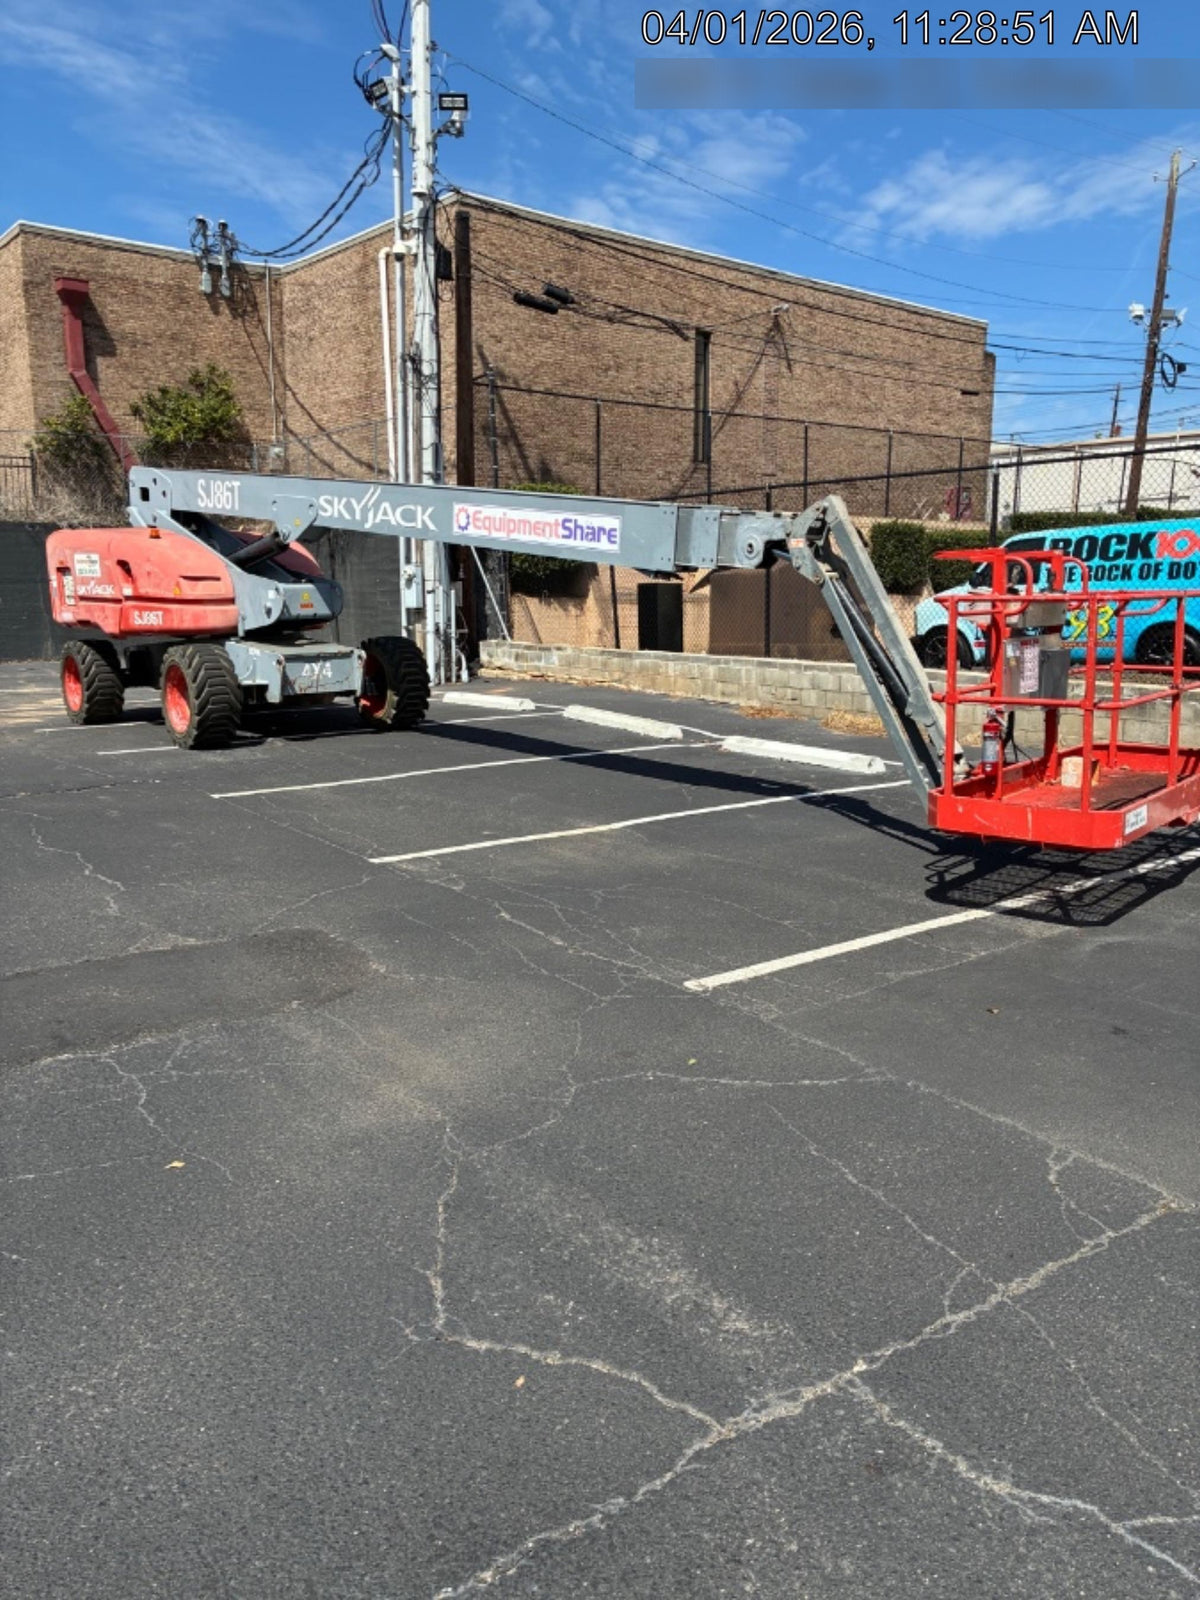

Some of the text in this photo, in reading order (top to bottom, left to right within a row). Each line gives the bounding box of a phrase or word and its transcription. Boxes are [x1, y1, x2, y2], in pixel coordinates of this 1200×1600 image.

[197, 479, 241, 511] SJ86T
[318, 485, 439, 531] SKYJACK
[472, 510, 618, 544] EquipmentShare
[1138, 562, 1164, 580] OF
[1168, 561, 1200, 581] DO
[133, 610, 164, 626] SJ86T
